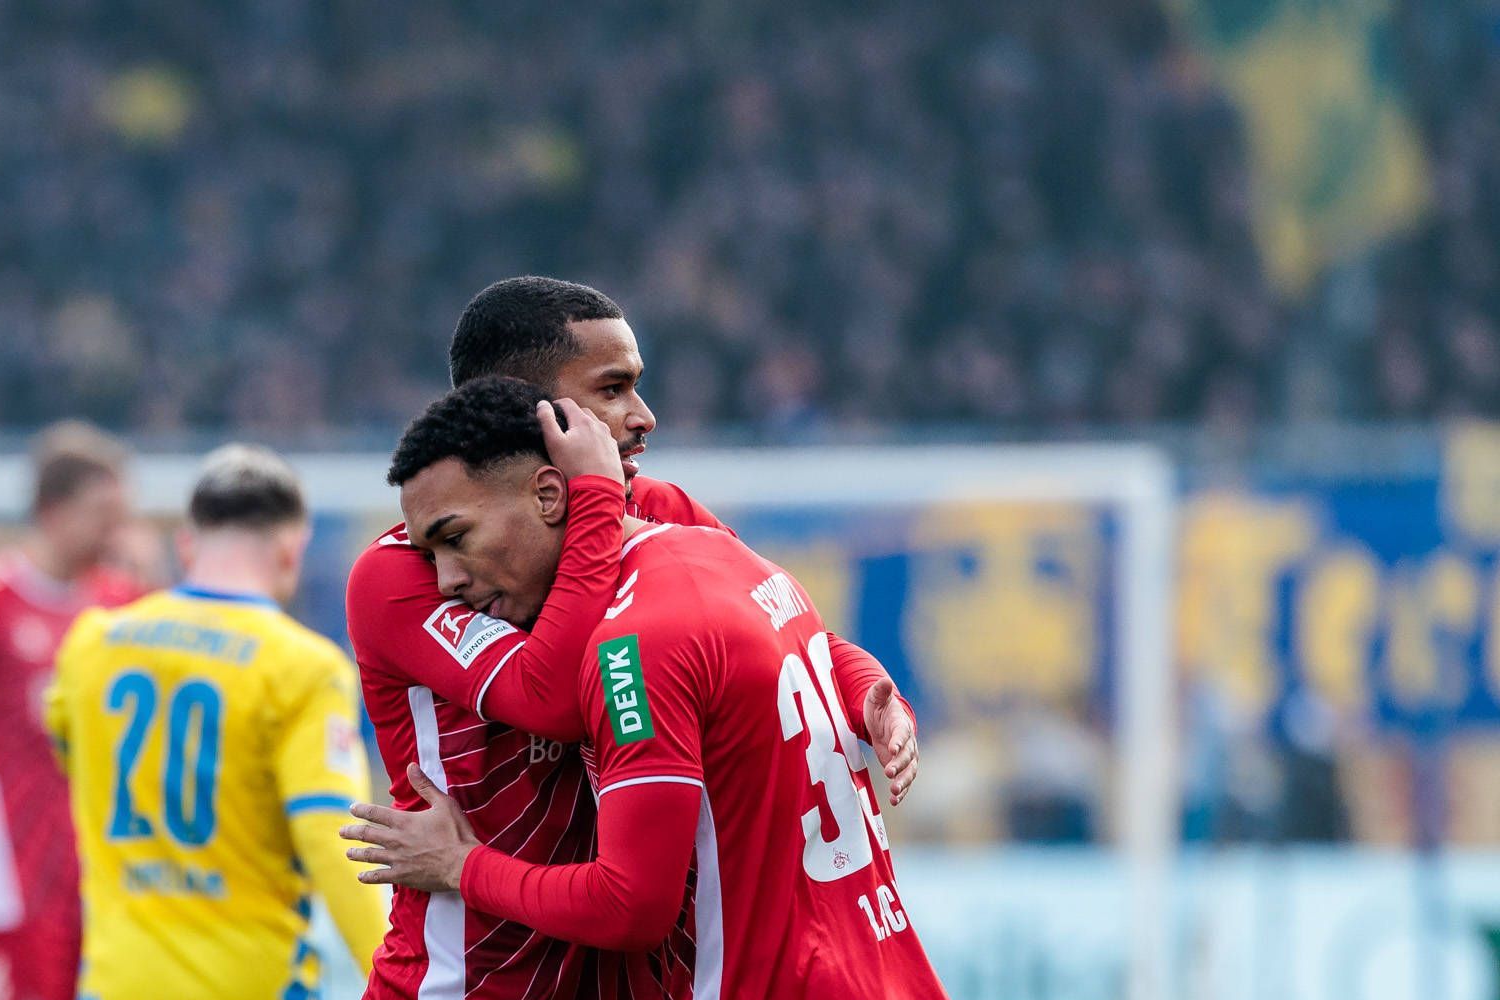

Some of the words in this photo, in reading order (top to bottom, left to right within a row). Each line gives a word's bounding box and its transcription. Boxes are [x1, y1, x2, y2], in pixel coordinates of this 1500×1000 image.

[462, 625, 509, 661] BUNDESLIGA
[606, 645, 643, 735] DEVK
[105, 671, 222, 847] 20
